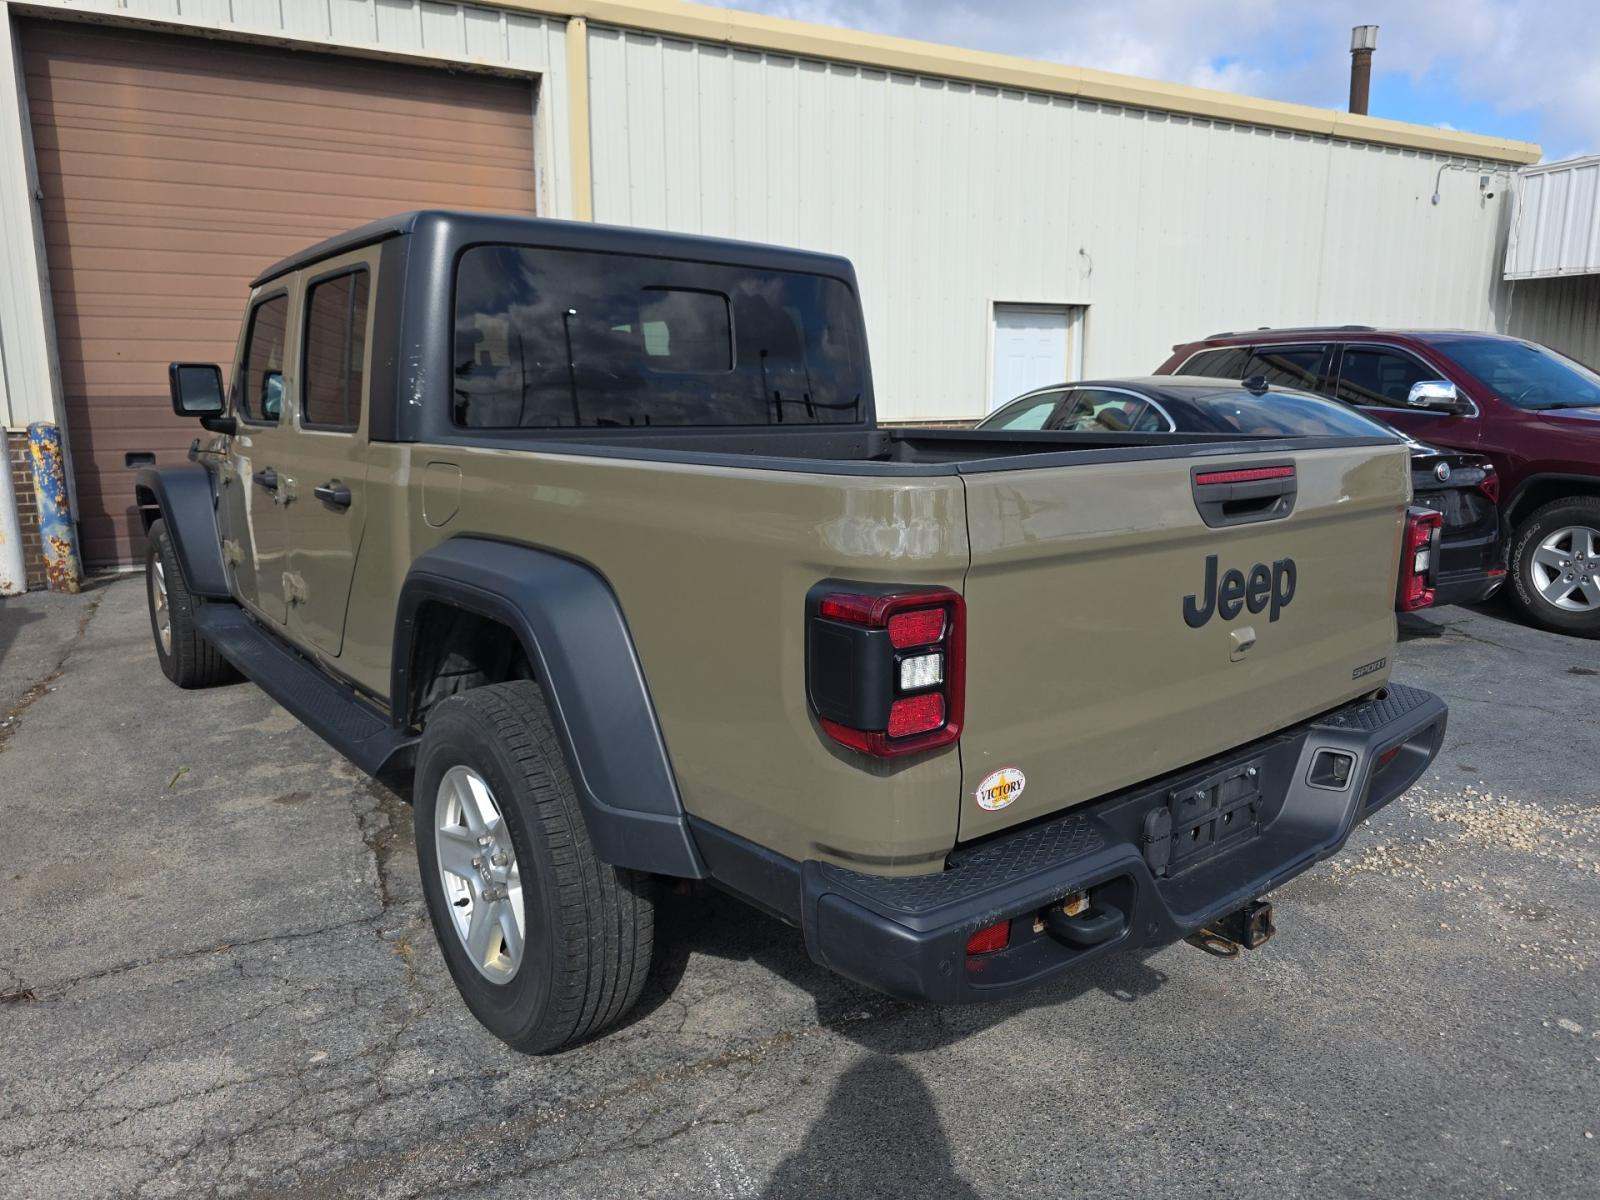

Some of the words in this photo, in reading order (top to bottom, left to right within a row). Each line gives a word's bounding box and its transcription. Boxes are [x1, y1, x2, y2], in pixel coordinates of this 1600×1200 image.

[1183, 555, 1297, 628] Jeep
[1353, 658, 1386, 679] SPORT
[981, 779, 1023, 801] VICTORY
